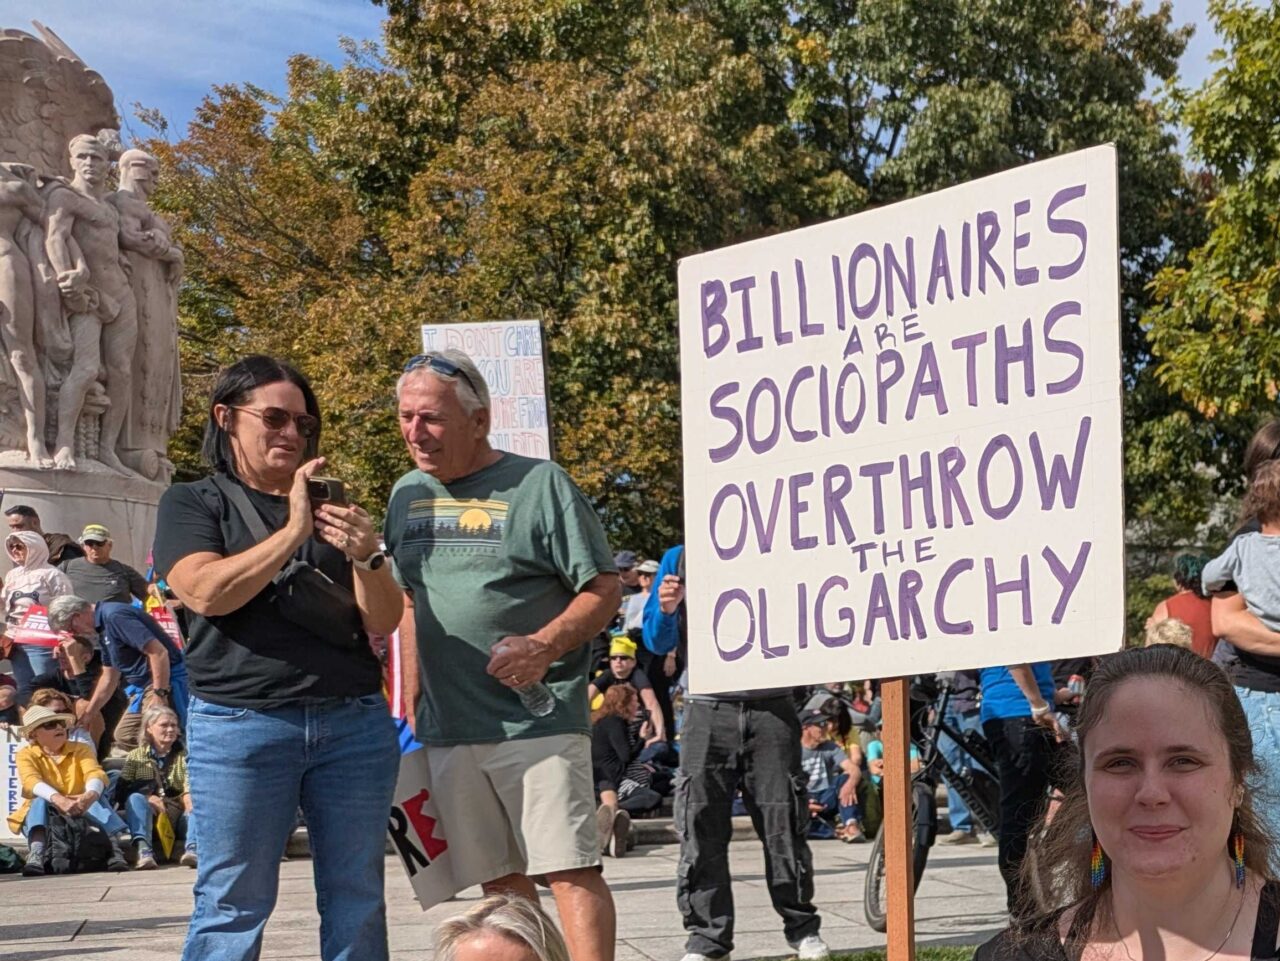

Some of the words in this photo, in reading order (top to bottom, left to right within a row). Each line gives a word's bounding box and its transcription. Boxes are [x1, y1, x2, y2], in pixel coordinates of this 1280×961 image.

[701, 184, 1088, 359] BILLIONAIRES
[504, 325, 542, 357] CARE
[511, 358, 546, 396] ARE
[843, 314, 925, 360] ARE
[709, 301, 1084, 463] SOCIOPATHS
[709, 416, 1092, 560] OVERTHROW
[851, 536, 936, 572] THE
[713, 541, 1092, 662] OLIGARCHY
